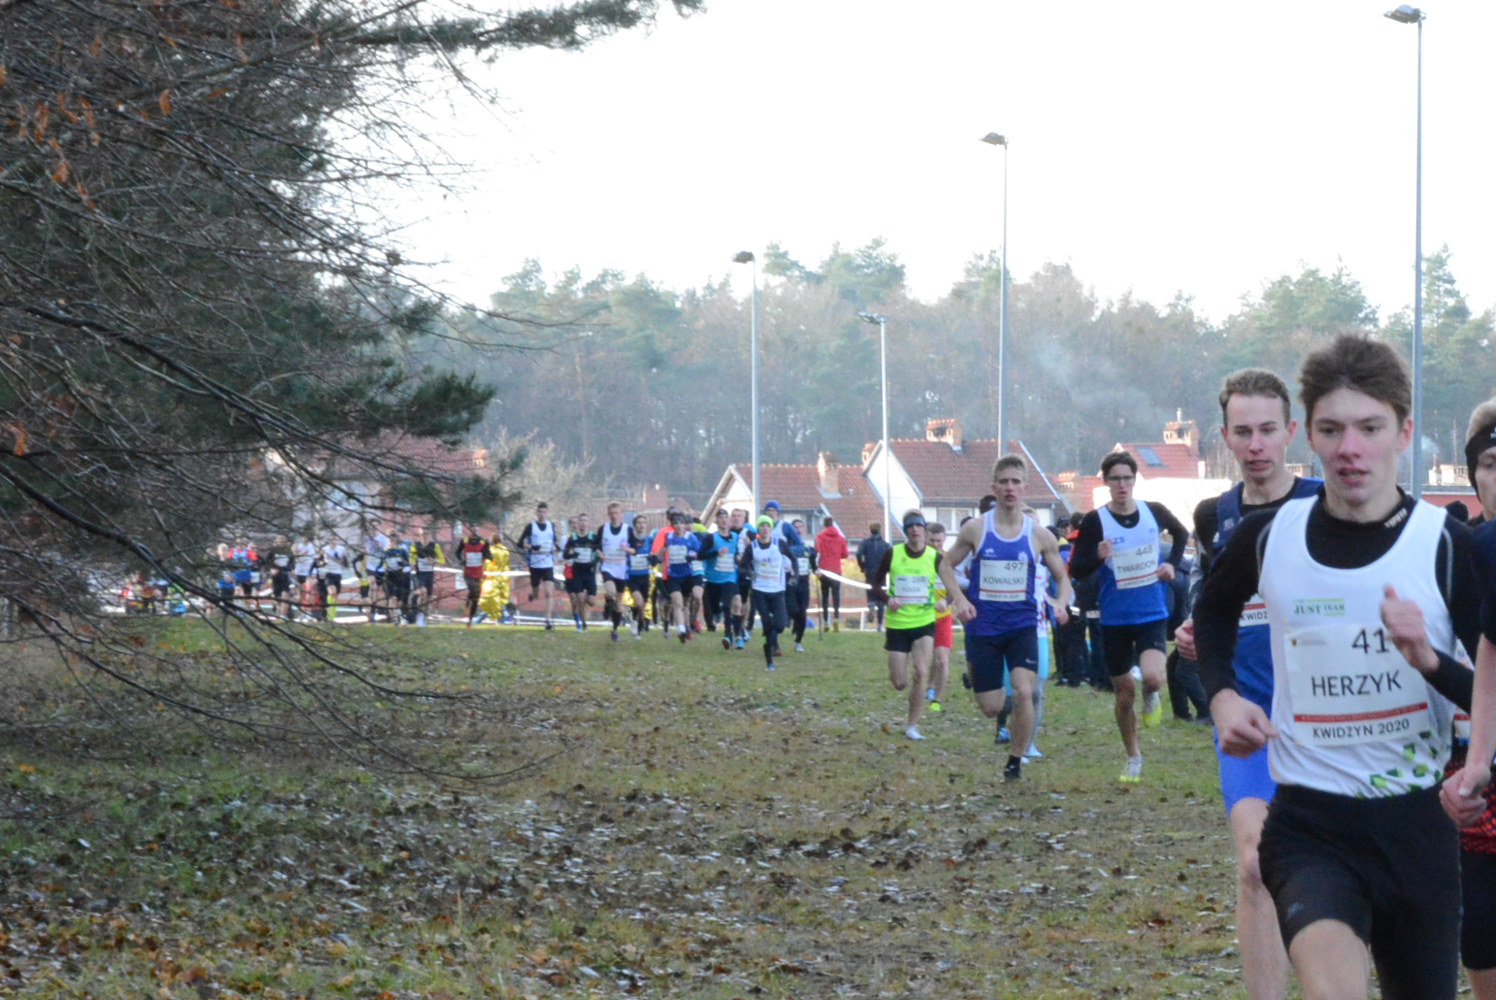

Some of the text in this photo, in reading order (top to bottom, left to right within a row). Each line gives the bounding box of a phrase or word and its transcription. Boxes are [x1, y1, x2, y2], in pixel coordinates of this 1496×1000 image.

[1004, 562, 1024, 571] 497
[982, 576, 1025, 585] KOWALSKI
[1311, 670, 1402, 698] HERZYK
[1312, 718, 1410, 739] KWIDZYN 2020
